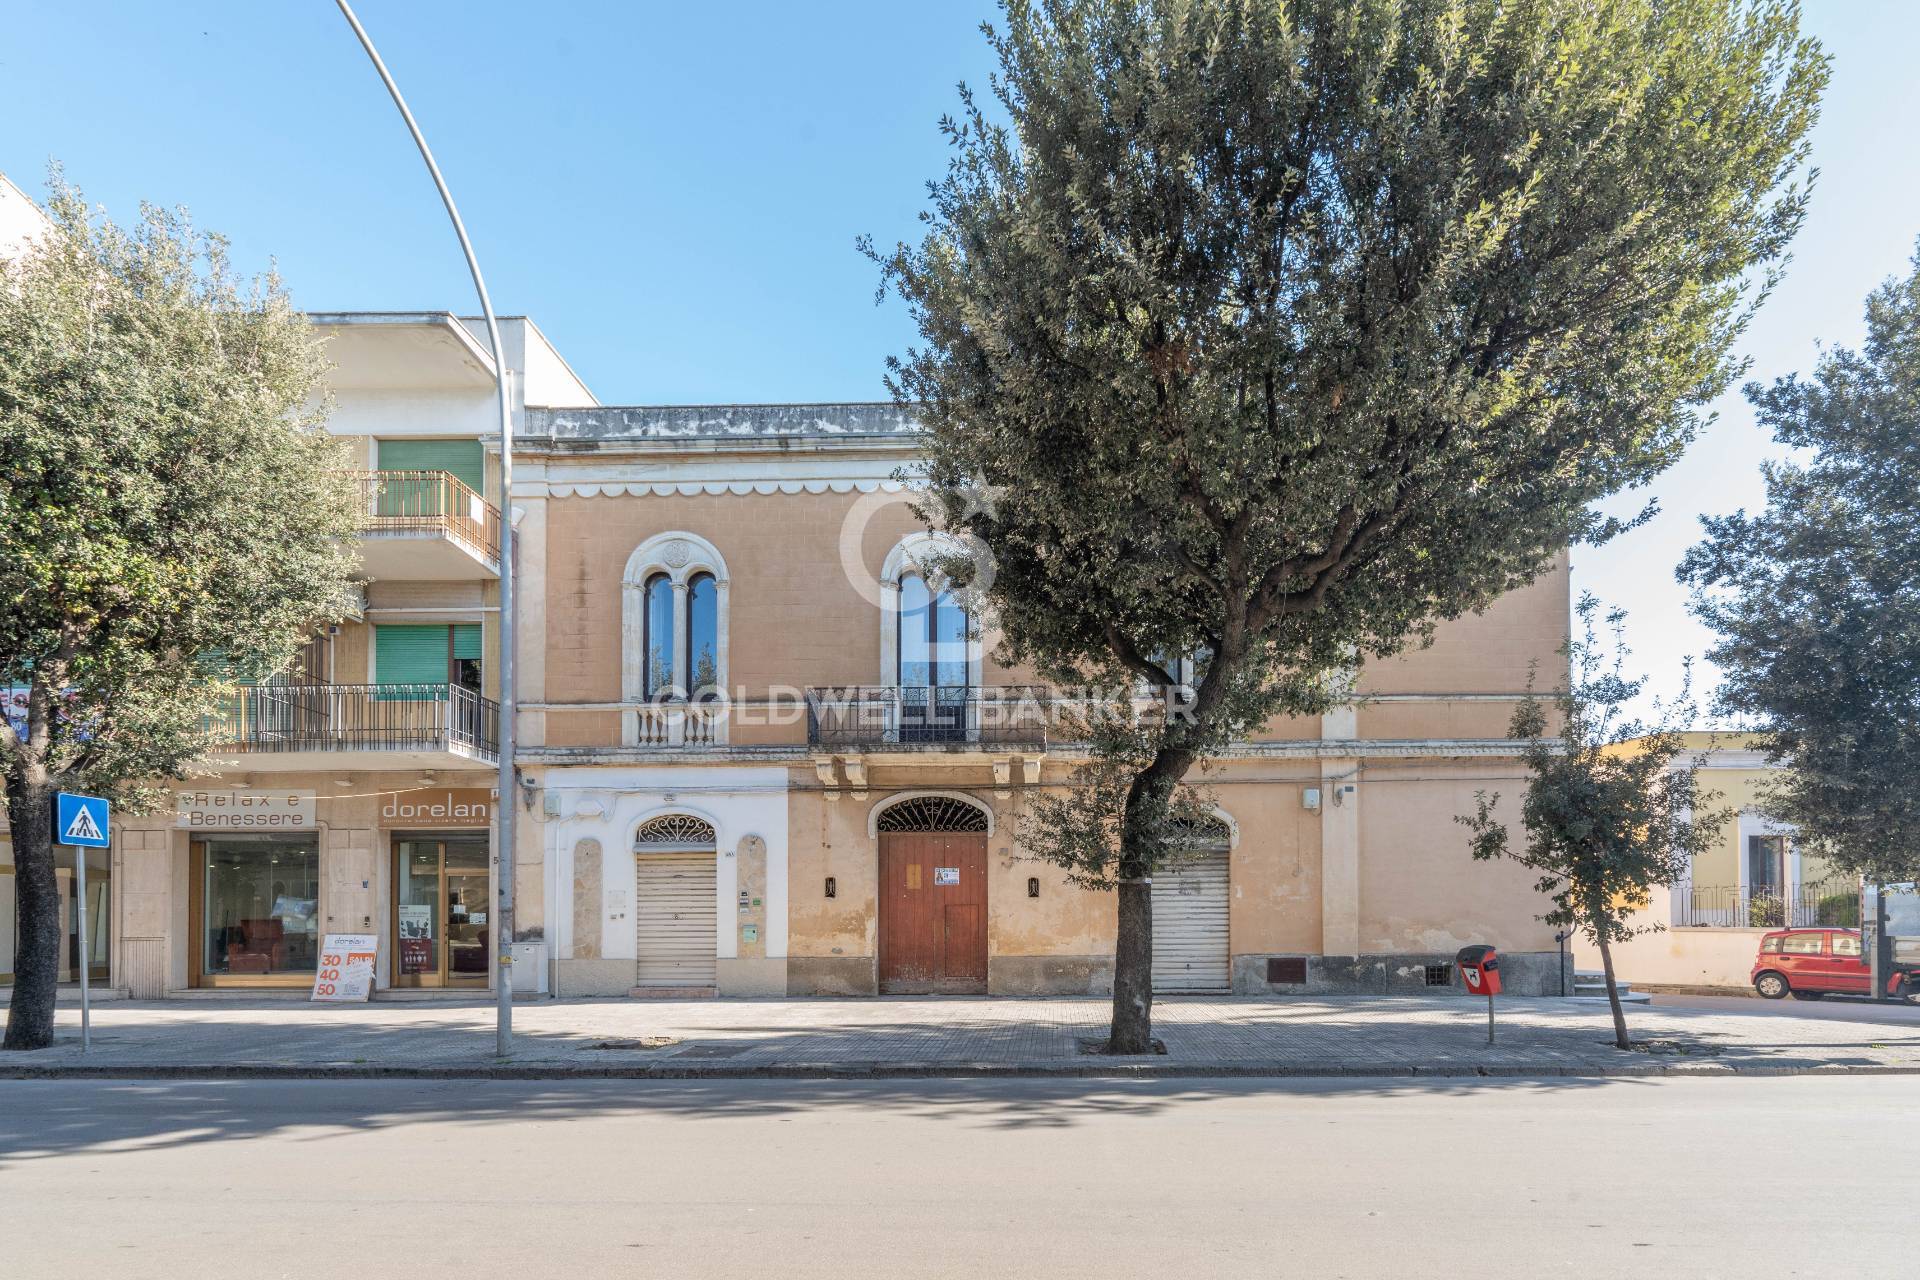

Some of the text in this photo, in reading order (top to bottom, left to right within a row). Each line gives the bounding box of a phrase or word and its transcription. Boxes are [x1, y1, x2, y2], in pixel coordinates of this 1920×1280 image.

[195, 791, 299, 806] Relax e
[382, 793, 486, 817] dorelan
[190, 811, 303, 826] Benessere
[334, 936, 366, 945] dorelan
[322, 954, 342, 967] 30
[320, 969, 340, 981] 40
[317, 983, 336, 996] 50
